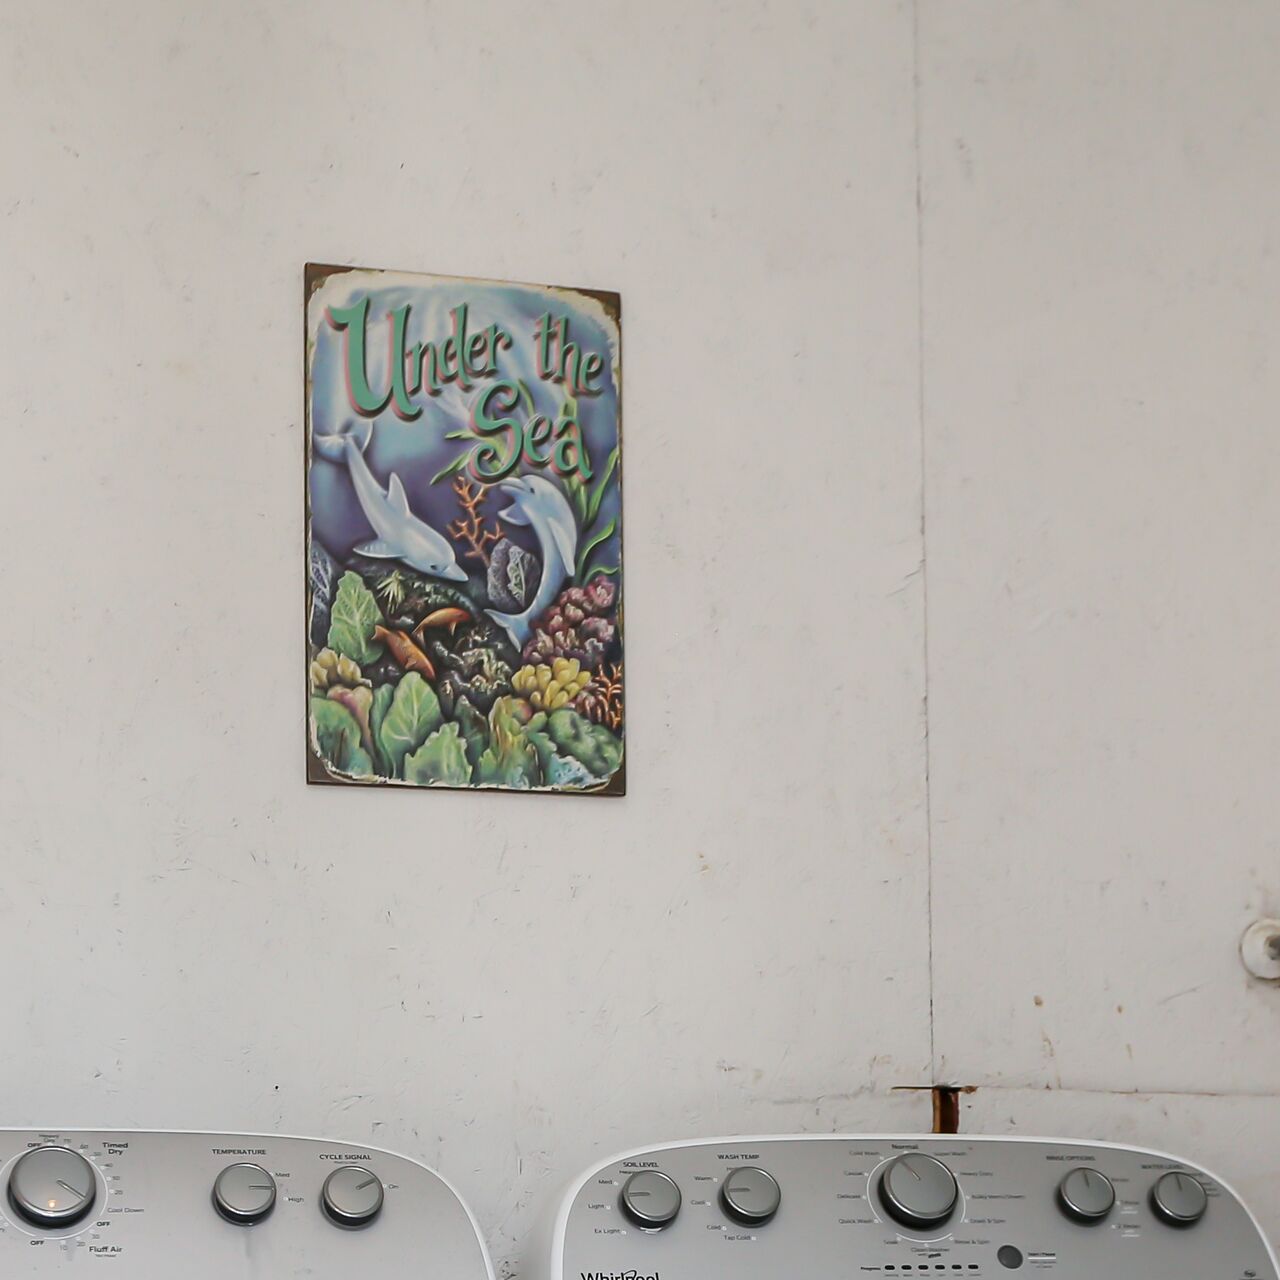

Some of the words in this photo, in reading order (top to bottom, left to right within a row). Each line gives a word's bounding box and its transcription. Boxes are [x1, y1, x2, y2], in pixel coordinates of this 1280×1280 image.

[324, 296, 513, 422] Under
[533, 311, 604, 397] the
[469, 380, 593, 486] Sea
